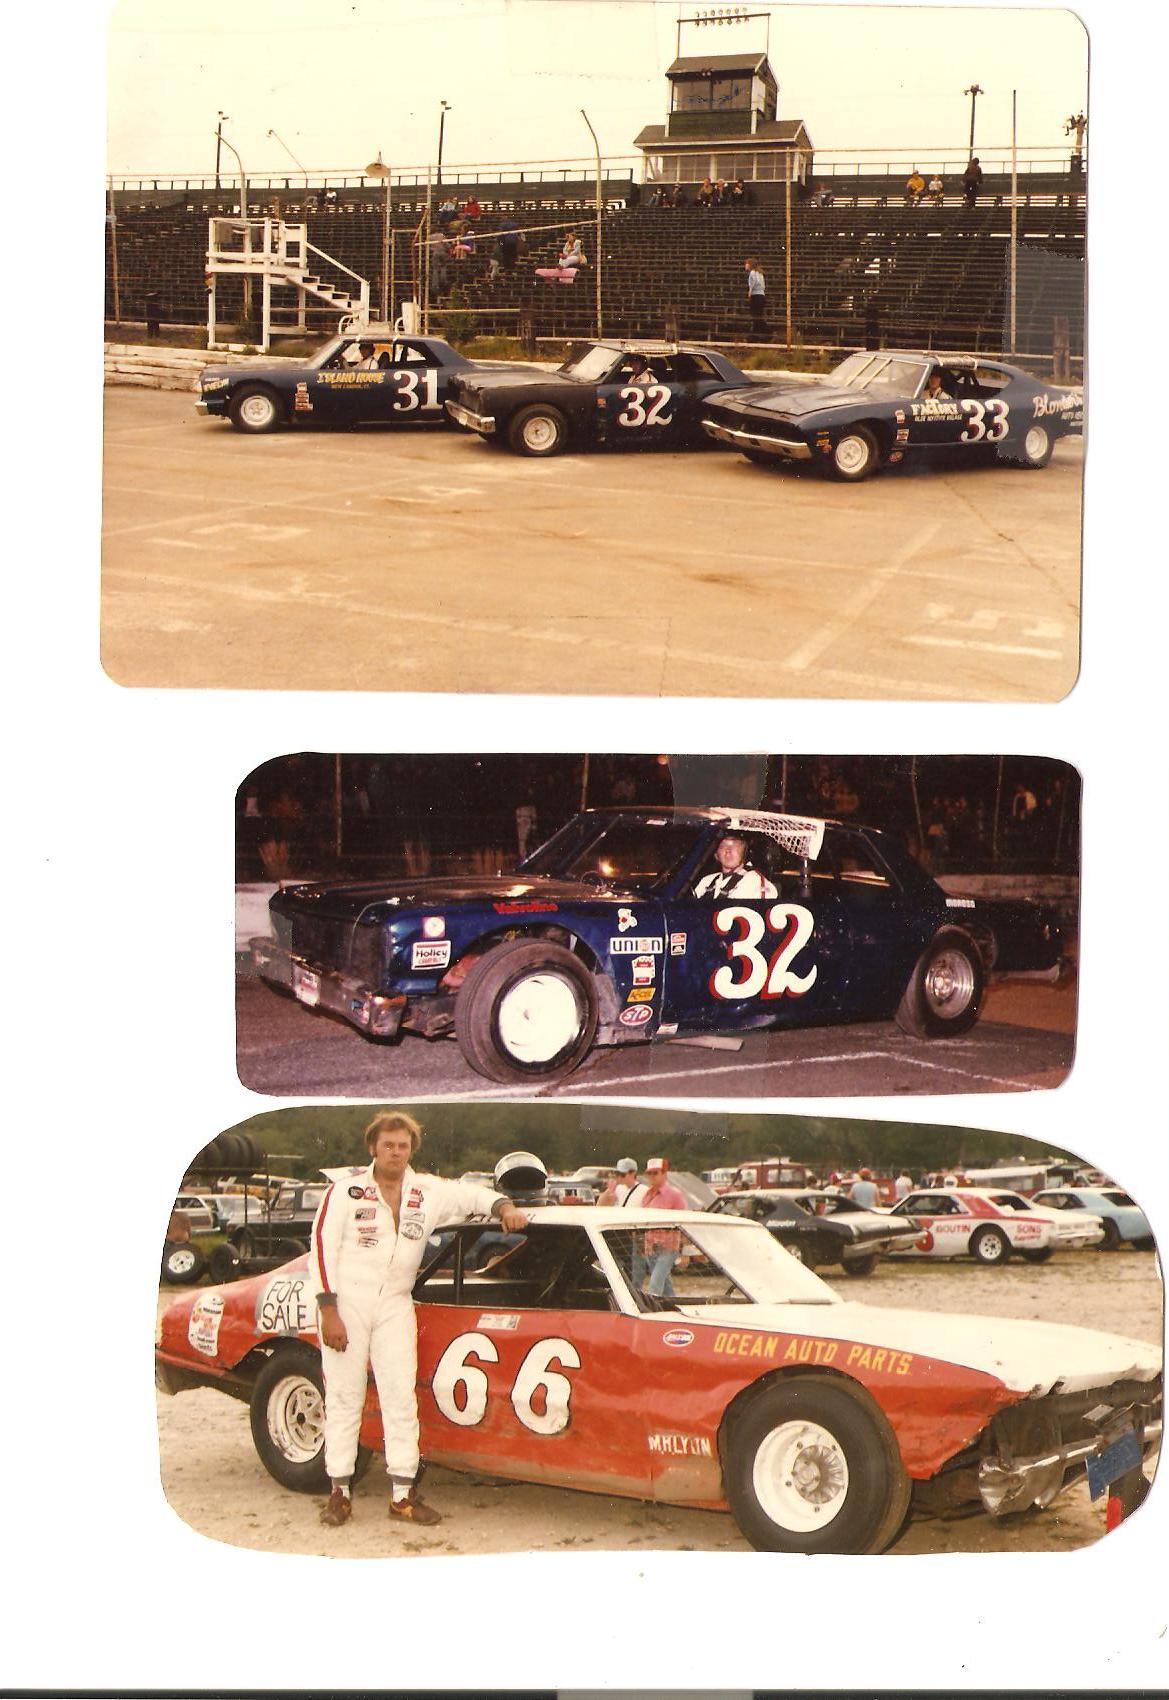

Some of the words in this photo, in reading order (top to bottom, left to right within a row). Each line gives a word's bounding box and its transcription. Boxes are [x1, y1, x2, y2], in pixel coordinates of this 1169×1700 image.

[393, 370, 443, 412] 31
[619, 385, 673, 427] 32
[960, 399, 1010, 442] 33
[708, 903, 818, 1000] 32
[622, 1007, 650, 1021] STP
[267, 1281, 304, 1303] FOR
[262, 1302, 307, 1330] SALE
[713, 1332, 778, 1359] OCEAN
[784, 1340, 839, 1365] AUTO
[847, 1345, 913, 1375] PARTS
[431, 1331, 582, 1436] 66
